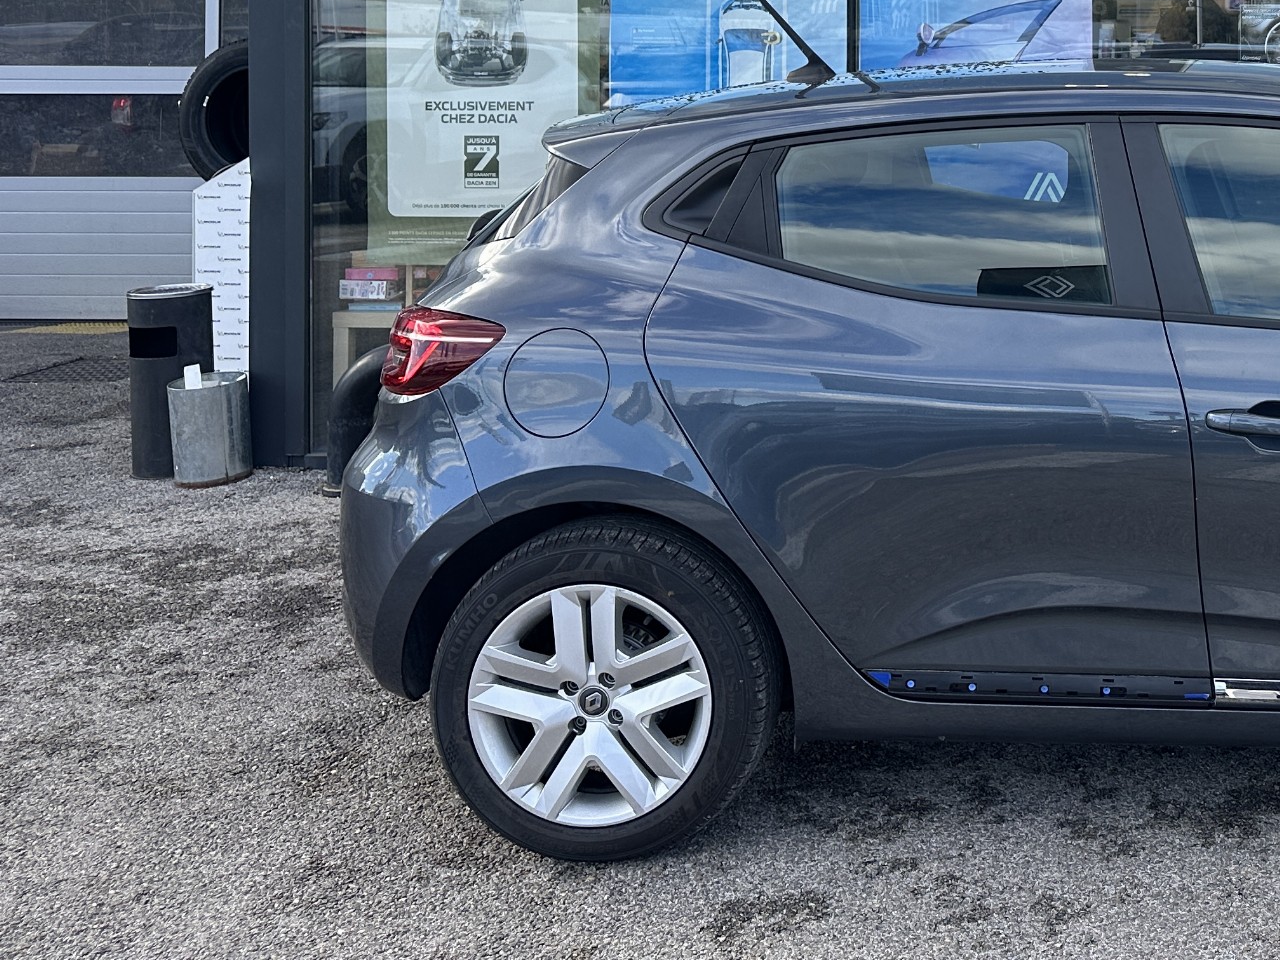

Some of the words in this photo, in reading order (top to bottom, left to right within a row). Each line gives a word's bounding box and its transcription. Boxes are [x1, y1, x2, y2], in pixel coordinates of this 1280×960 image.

[425, 101, 535, 111] EXCLUSIVEMENT
[441, 114, 475, 124] CHEZ
[478, 114, 518, 124] DACIA
[446, 593, 498, 670] KUMHO
